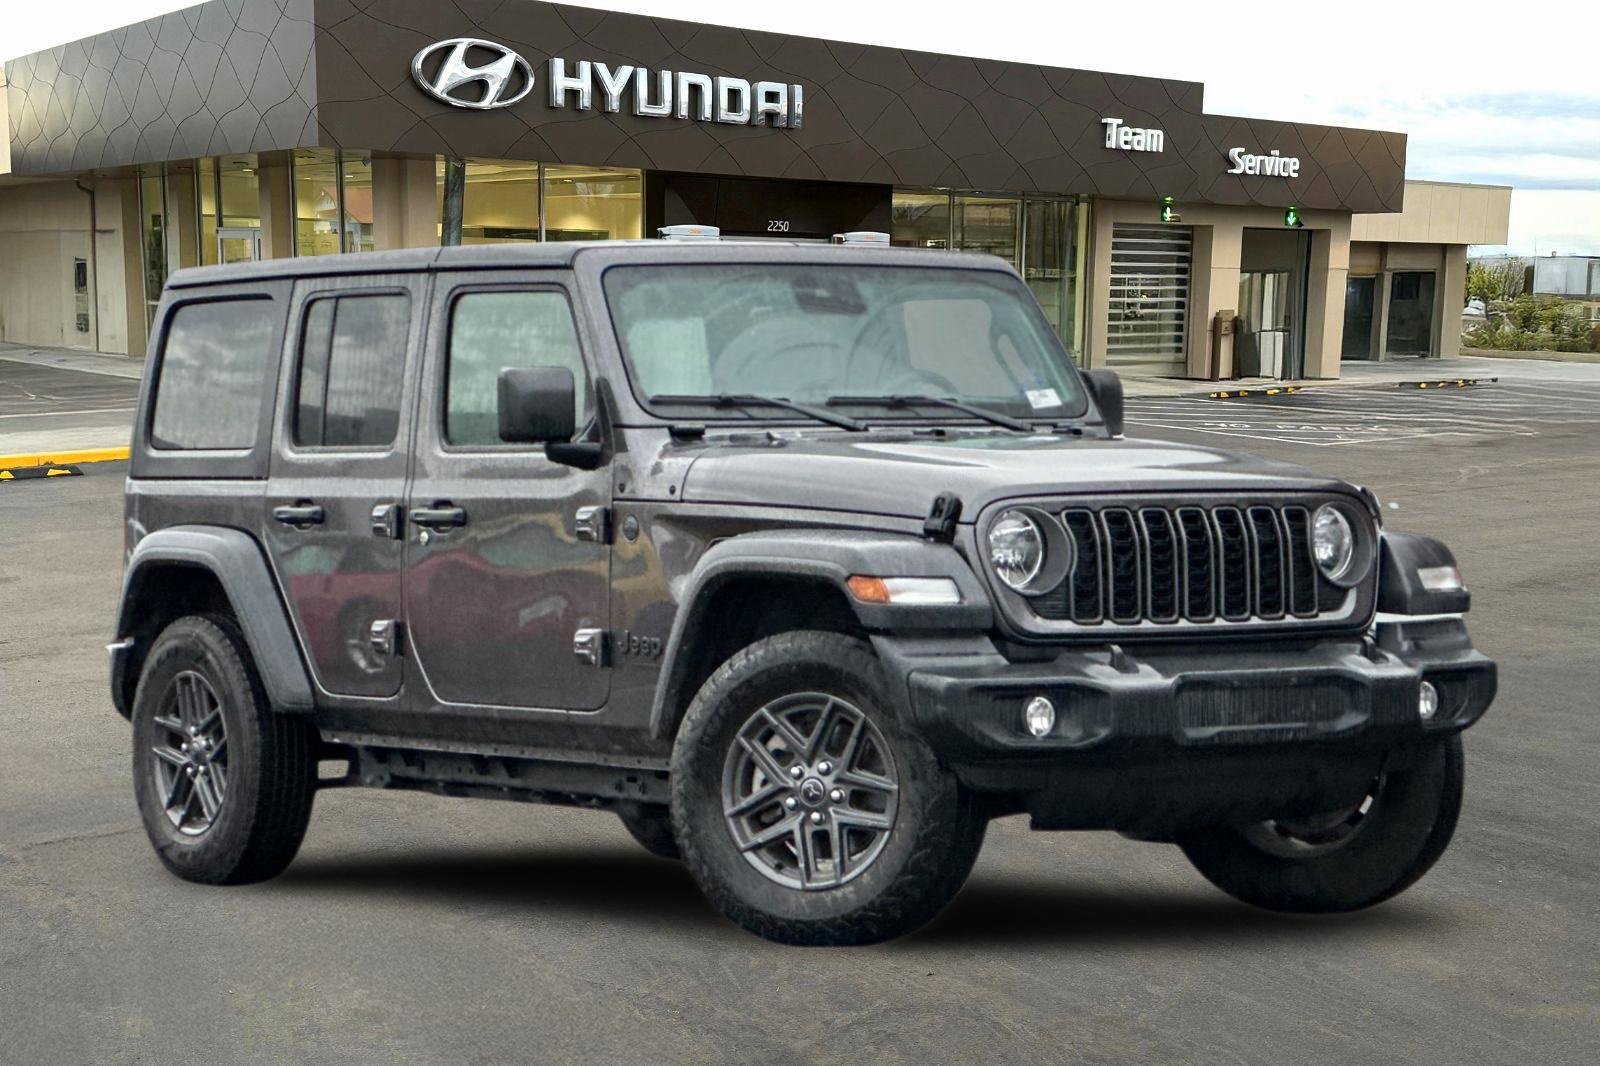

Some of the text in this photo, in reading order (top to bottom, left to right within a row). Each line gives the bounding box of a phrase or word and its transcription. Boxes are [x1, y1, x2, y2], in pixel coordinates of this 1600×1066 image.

[549, 57, 803, 129] HYUNDAI
[1101, 117, 1164, 153] Team
[1227, 147, 1300, 178] Service
[767, 220, 790, 232] 2250
[617, 629, 661, 659] Jeep
